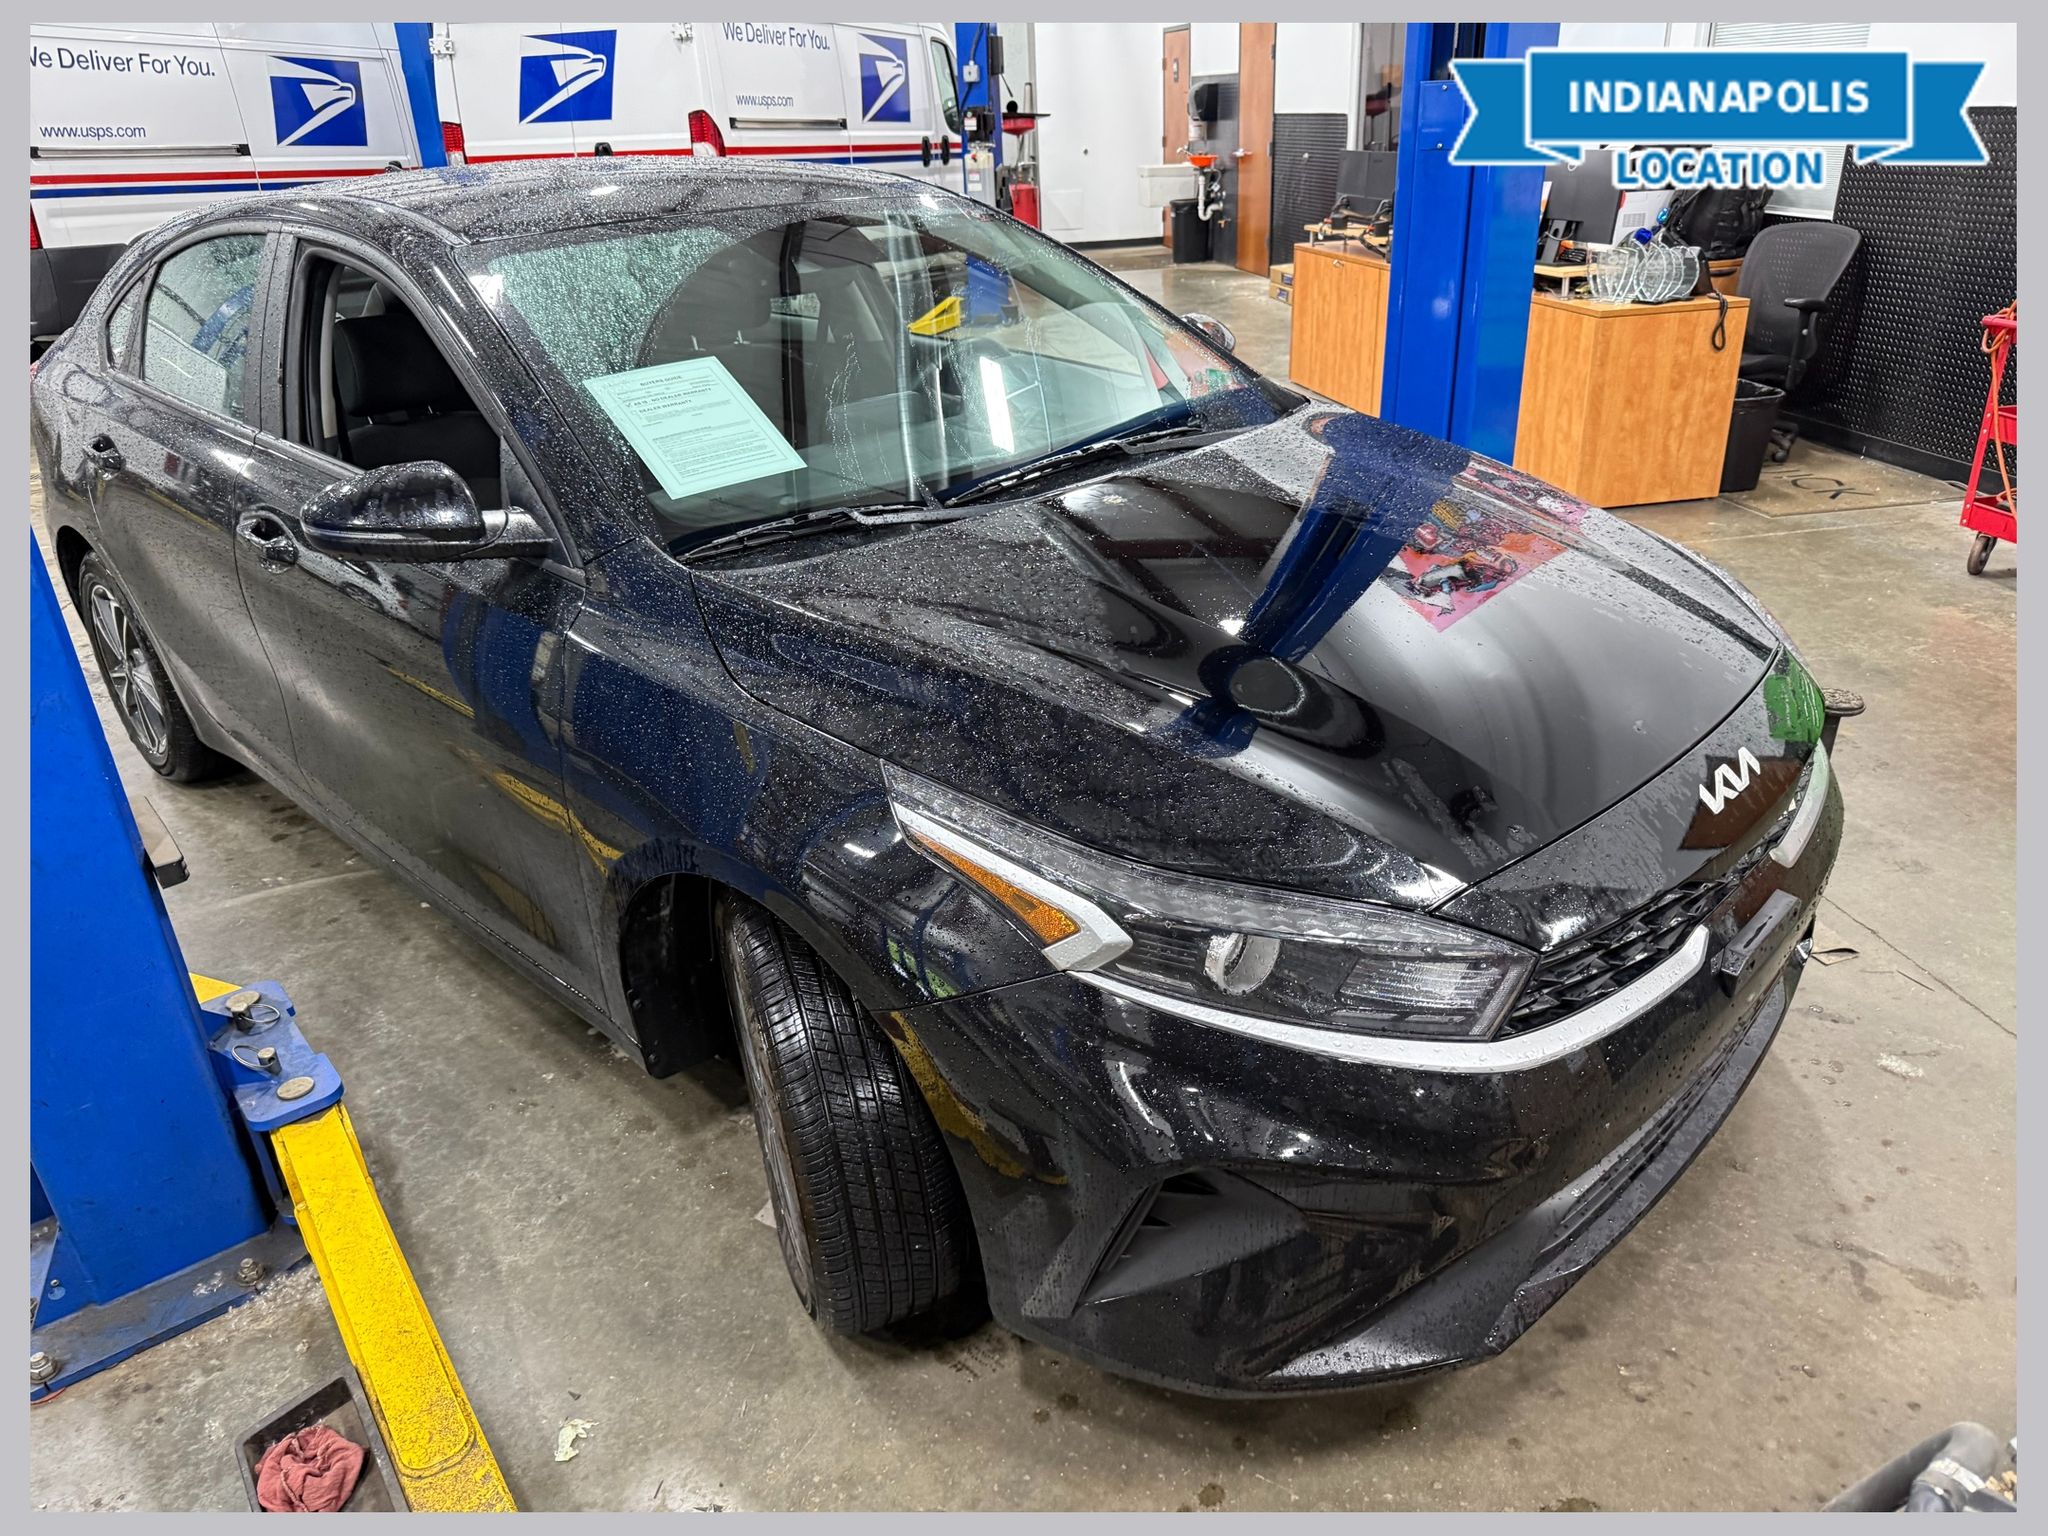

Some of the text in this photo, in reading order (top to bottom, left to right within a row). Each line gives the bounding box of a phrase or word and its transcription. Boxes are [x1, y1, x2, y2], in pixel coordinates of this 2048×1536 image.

[722, 22, 831, 51] We Deliver For You.
[57, 48, 134, 72] Deliver
[138, 53, 171, 74] For
[173, 55, 216, 76] You.
[735, 94, 794, 110] www.usps.com
[39, 126, 147, 141] www.usps.com
[1698, 746, 1761, 815] KIA
